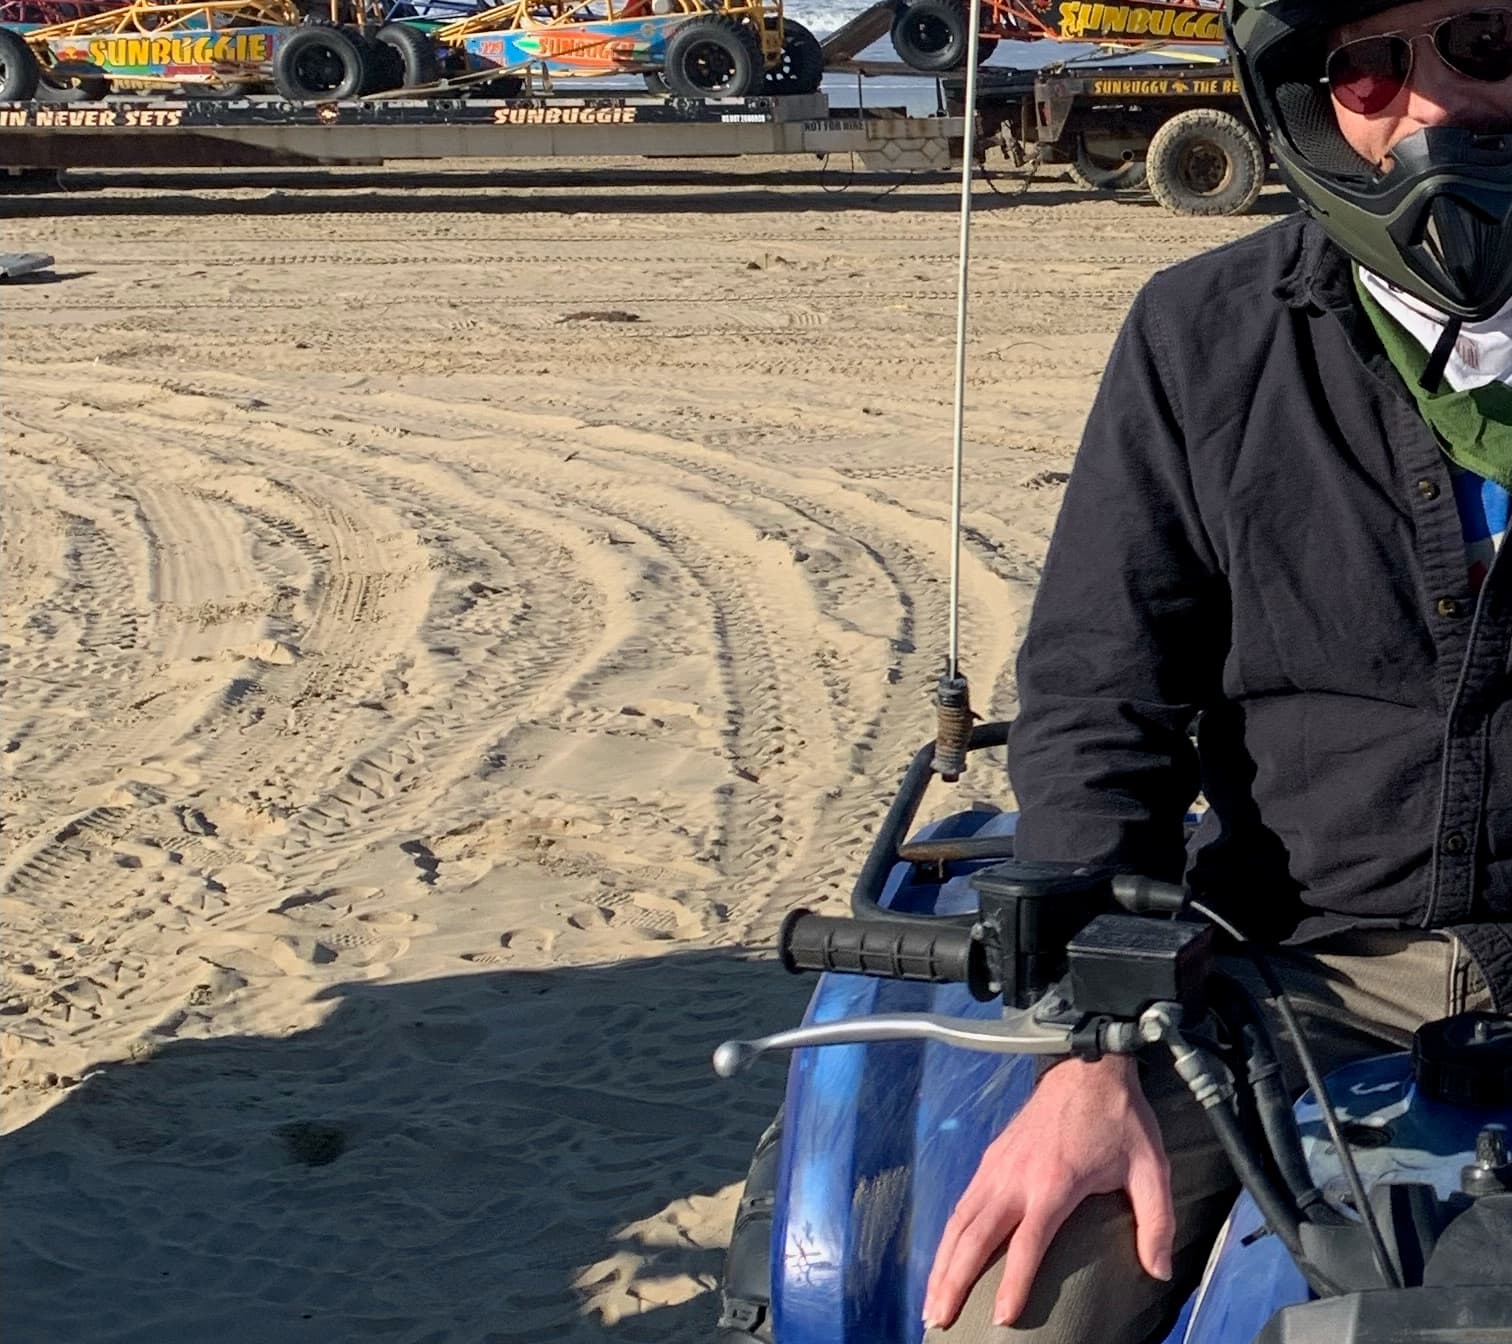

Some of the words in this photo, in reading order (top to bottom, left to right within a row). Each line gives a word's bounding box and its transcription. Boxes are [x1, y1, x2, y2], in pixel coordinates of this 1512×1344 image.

[88, 33, 267, 67] SUNBUGGIE
[1094, 80, 1168, 95] SUNBUGGY
[1193, 80, 1217, 94] THE
[36, 110, 117, 127] NEVER
[125, 110, 183, 127] SETS
[493, 107, 638, 125] SUNBUGGIE
